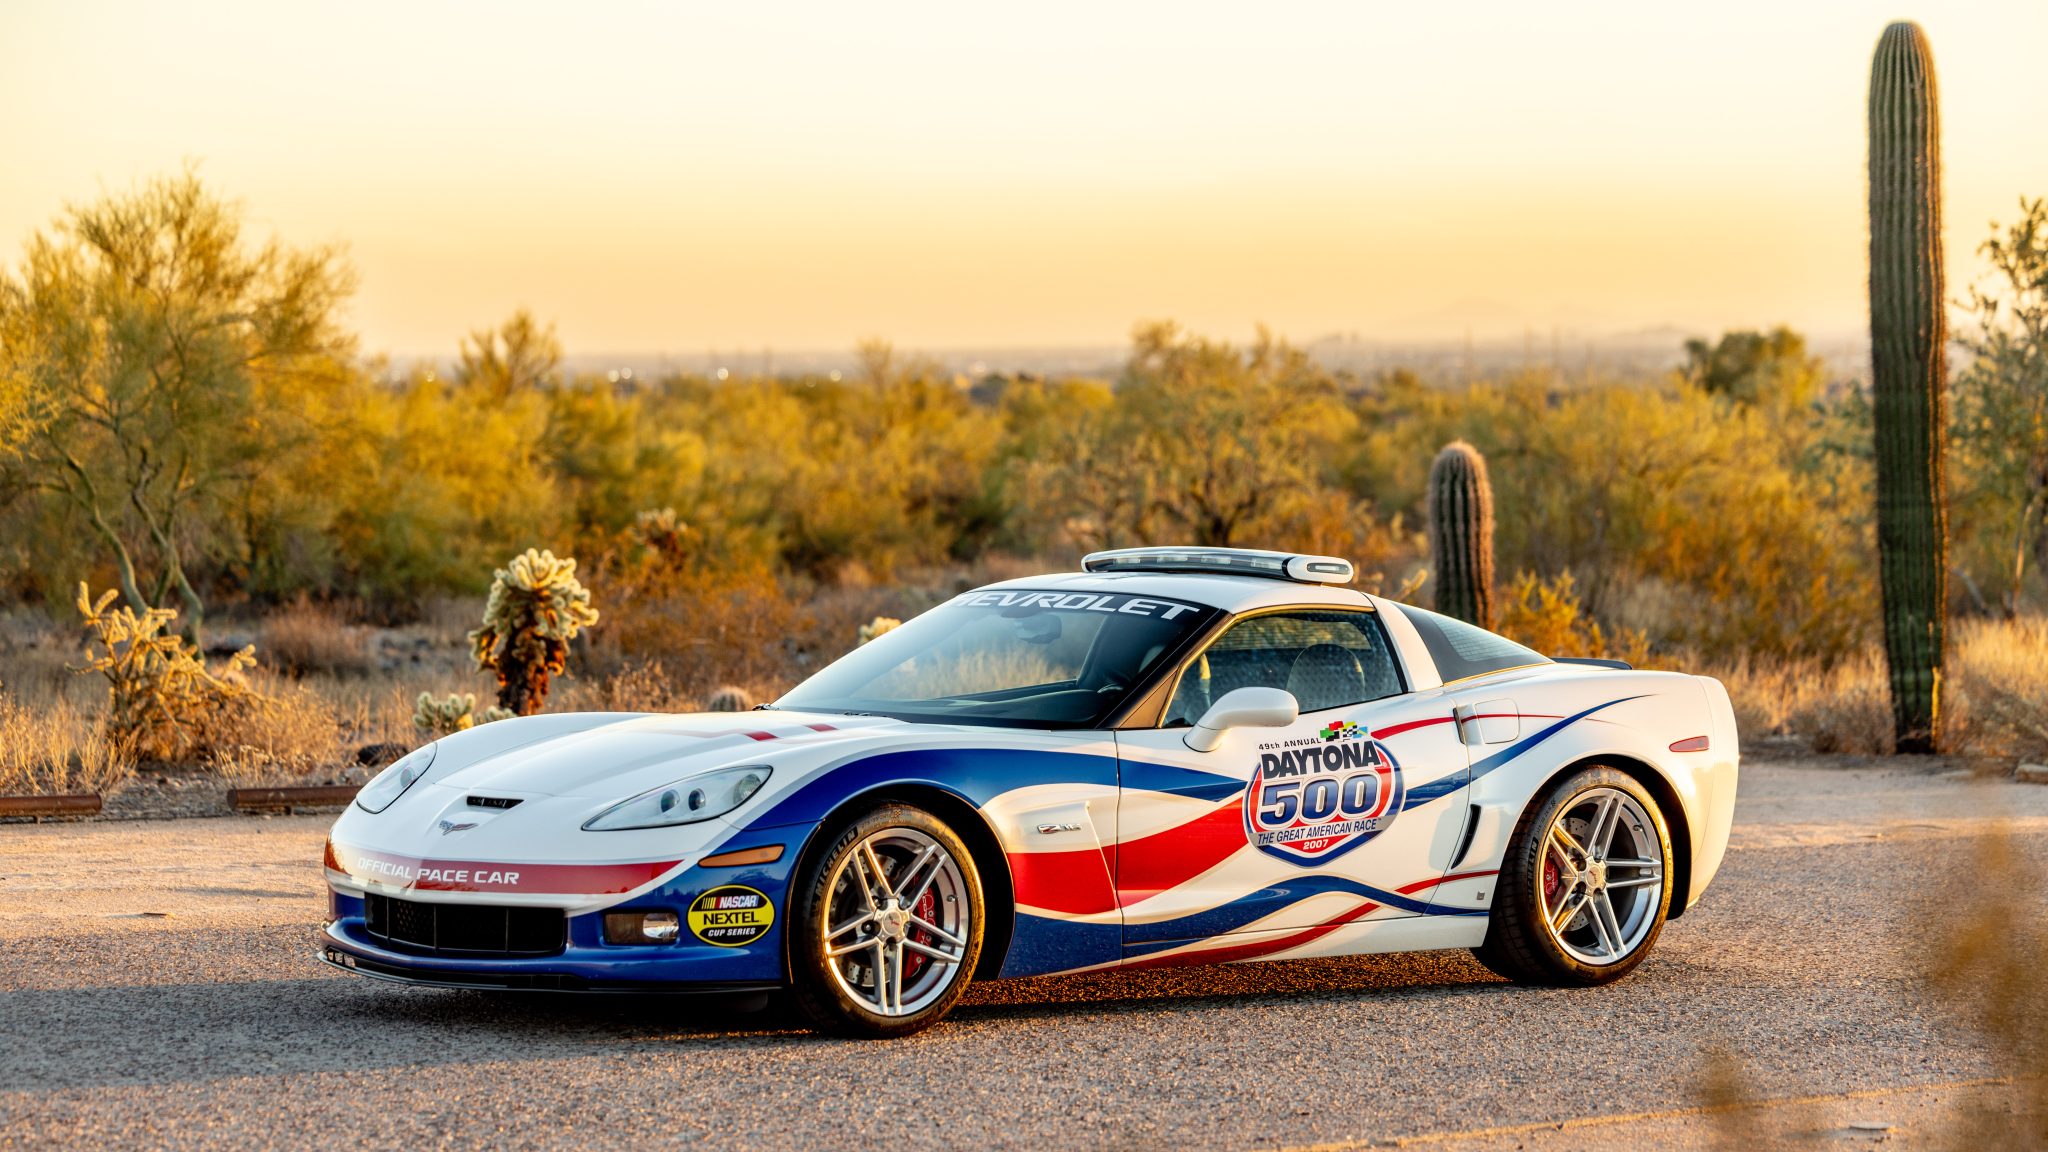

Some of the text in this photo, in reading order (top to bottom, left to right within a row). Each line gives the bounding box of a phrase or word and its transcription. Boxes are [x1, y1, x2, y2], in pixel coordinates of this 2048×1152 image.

[951, 592, 1200, 620] HEVROLET
[1284, 738, 1321, 747] ANNUAL
[1261, 740, 1381, 779] DAYTONA
[1259, 772, 1379, 826] 500
[1258, 833, 1275, 844] THE
[1277, 828, 1306, 842] GREAT
[1306, 821, 1352, 838] AMERICAN
[1303, 839, 1329, 850] 2007
[358, 857, 520, 885] OFFICIAL PACE CAR
[815, 829, 856, 895] MICHELIN
[719, 895, 759, 909] NASCAR
[703, 911, 759, 925] NEXTEL
[708, 927, 756, 937] CUP SERIES
